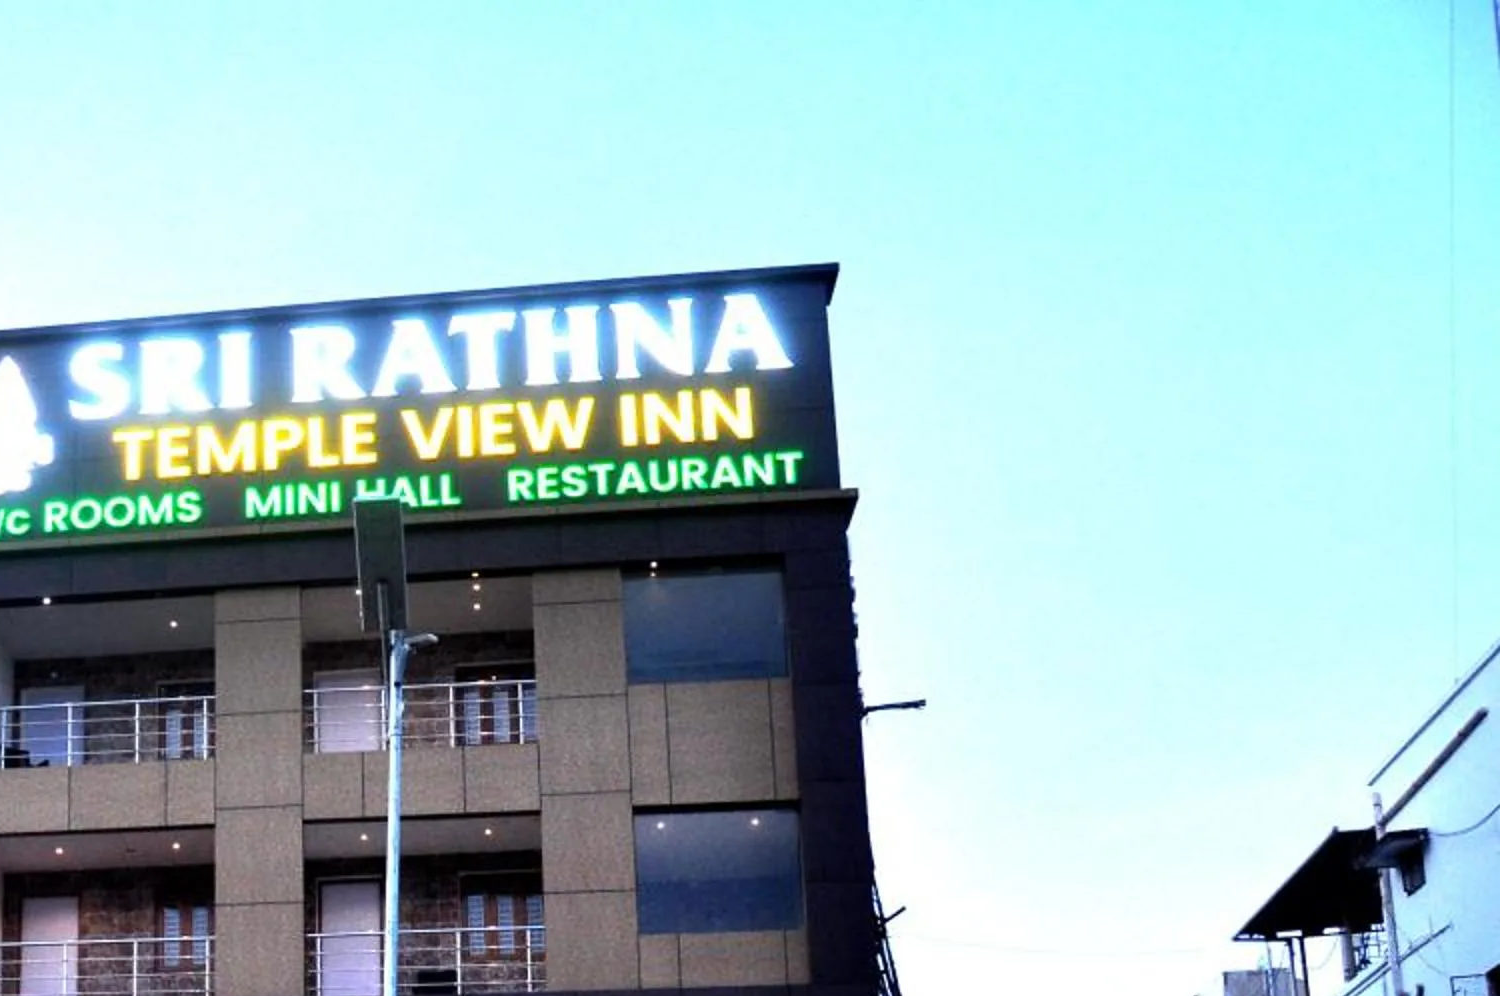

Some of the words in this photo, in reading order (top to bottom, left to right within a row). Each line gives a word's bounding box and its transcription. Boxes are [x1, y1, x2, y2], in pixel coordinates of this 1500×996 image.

[67, 330, 252, 421] SRI
[289, 291, 795, 406] RATHNA
[111, 411, 377, 481] TEMPLE
[400, 398, 595, 461] VIEW
[619, 387, 754, 448] INN
[43, 491, 203, 533] ROOMS
[244, 480, 342, 519] MINI
[508, 450, 804, 502] RESTAURANT
